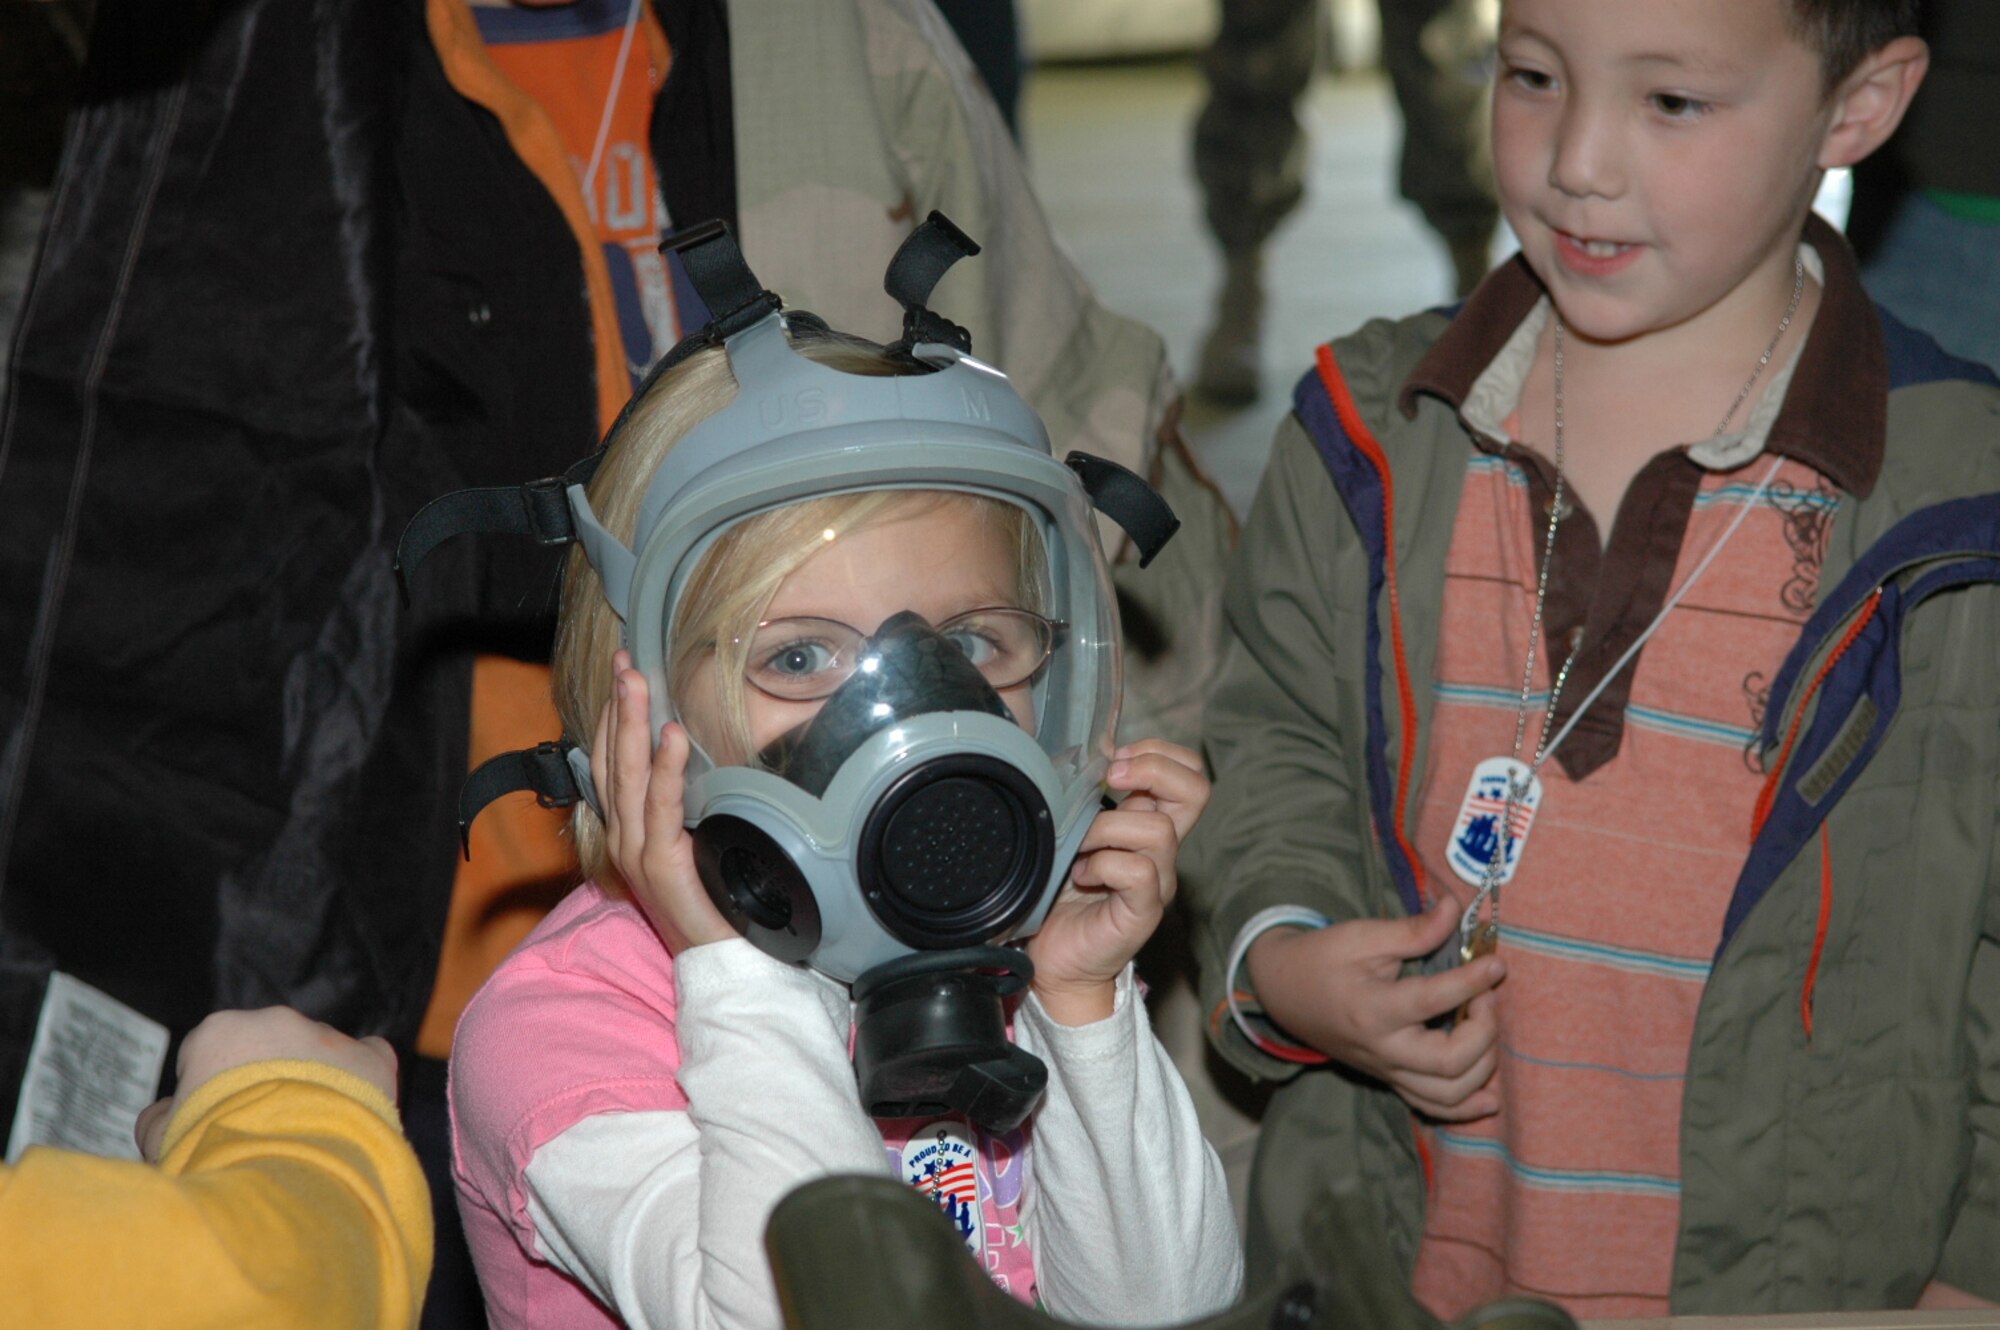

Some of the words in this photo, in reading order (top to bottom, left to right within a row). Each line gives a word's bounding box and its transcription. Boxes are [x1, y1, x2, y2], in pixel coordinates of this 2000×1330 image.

[759, 386, 827, 431] US
[959, 386, 992, 421] M
[909, 1145, 937, 1168] PROUD
[952, 1143, 965, 1154] BE
[963, 1149, 972, 1158] A
